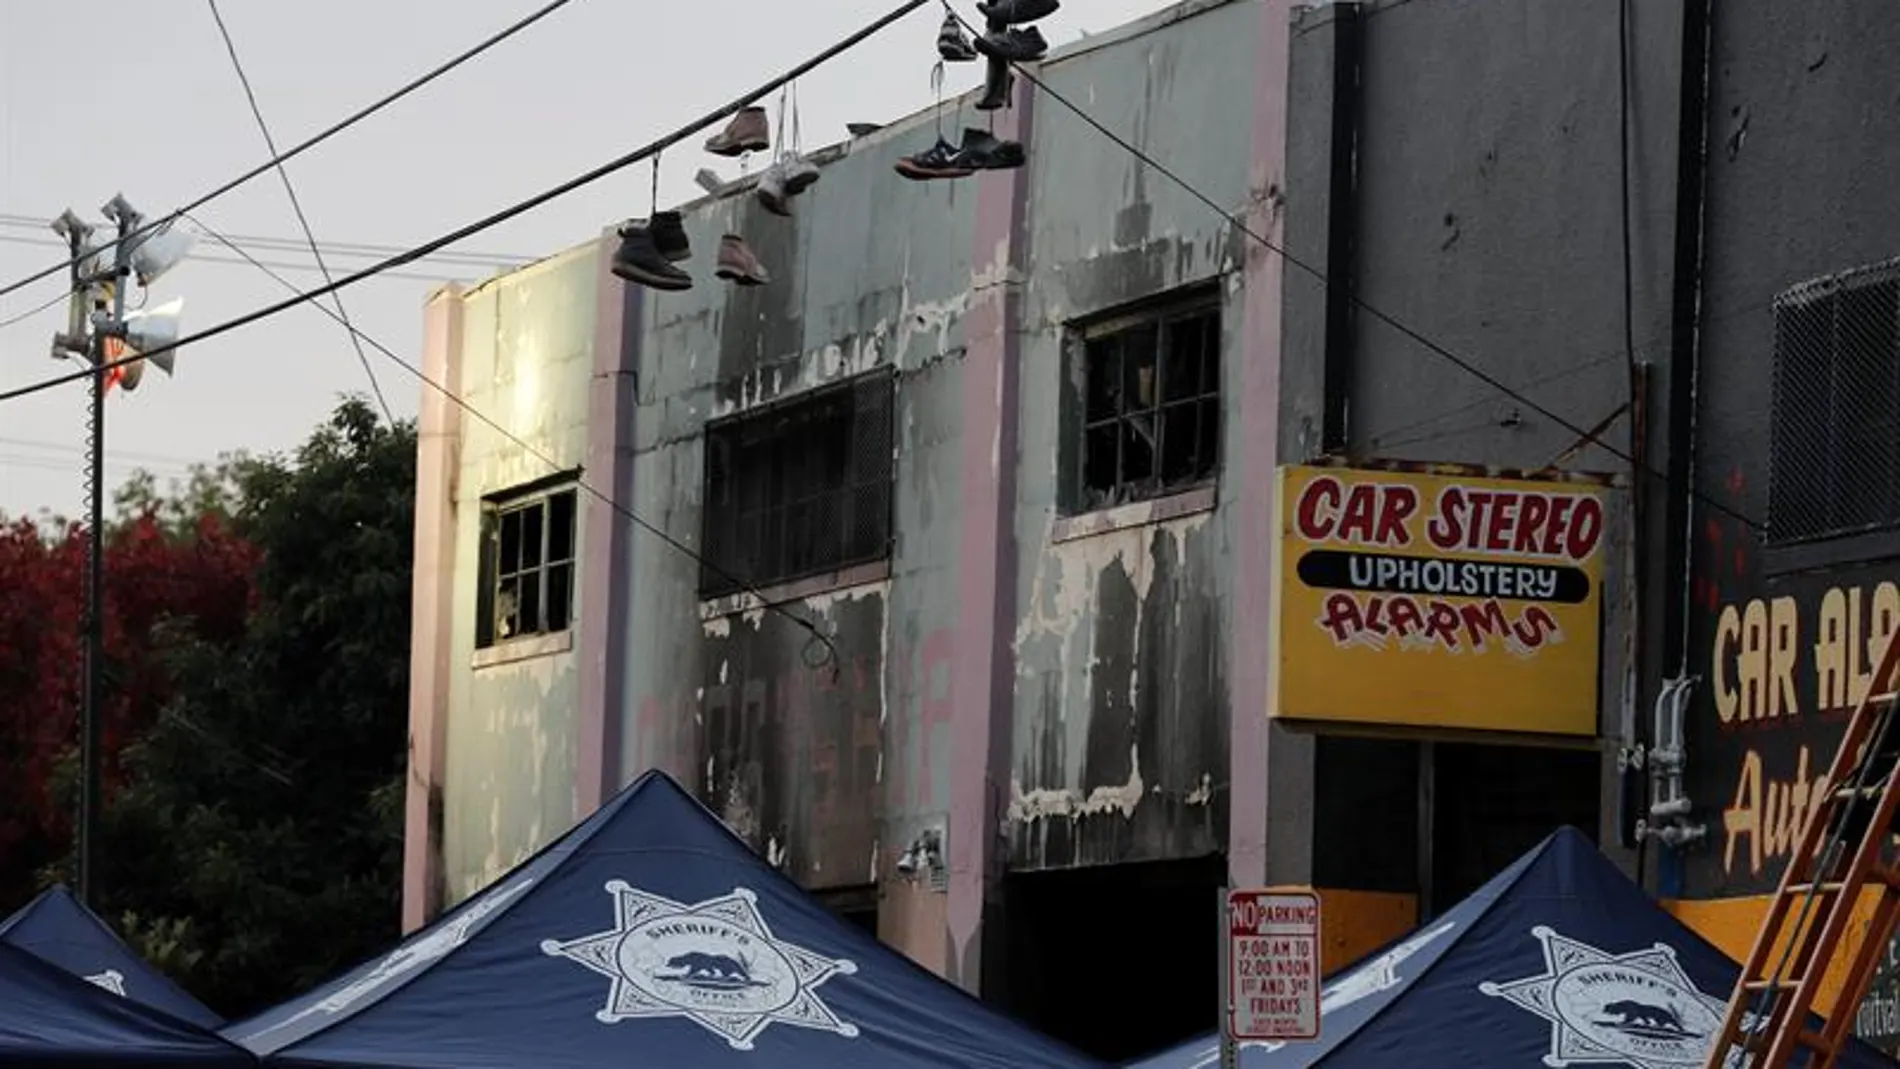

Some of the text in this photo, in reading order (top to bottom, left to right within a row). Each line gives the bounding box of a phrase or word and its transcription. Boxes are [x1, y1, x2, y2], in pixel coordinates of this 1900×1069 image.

[1298, 476, 1602, 561] CAR STEREO
[1349, 555, 1558, 598] UPHOLSTERY
[1320, 592, 1561, 652] ALARMS
[1713, 595, 1798, 723] CAR
[1231, 901, 1317, 929] NO PARKING
[645, 923, 750, 945] SHERIFF'S
[1274, 940, 1291, 957] AM
[1295, 940, 1309, 957] TO
[1277, 960, 1310, 977] NOON
[1261, 978, 1285, 996] AND
[1577, 971, 1678, 998] SHERIFF'S
[1251, 997, 1302, 1015] FRIDAYS
